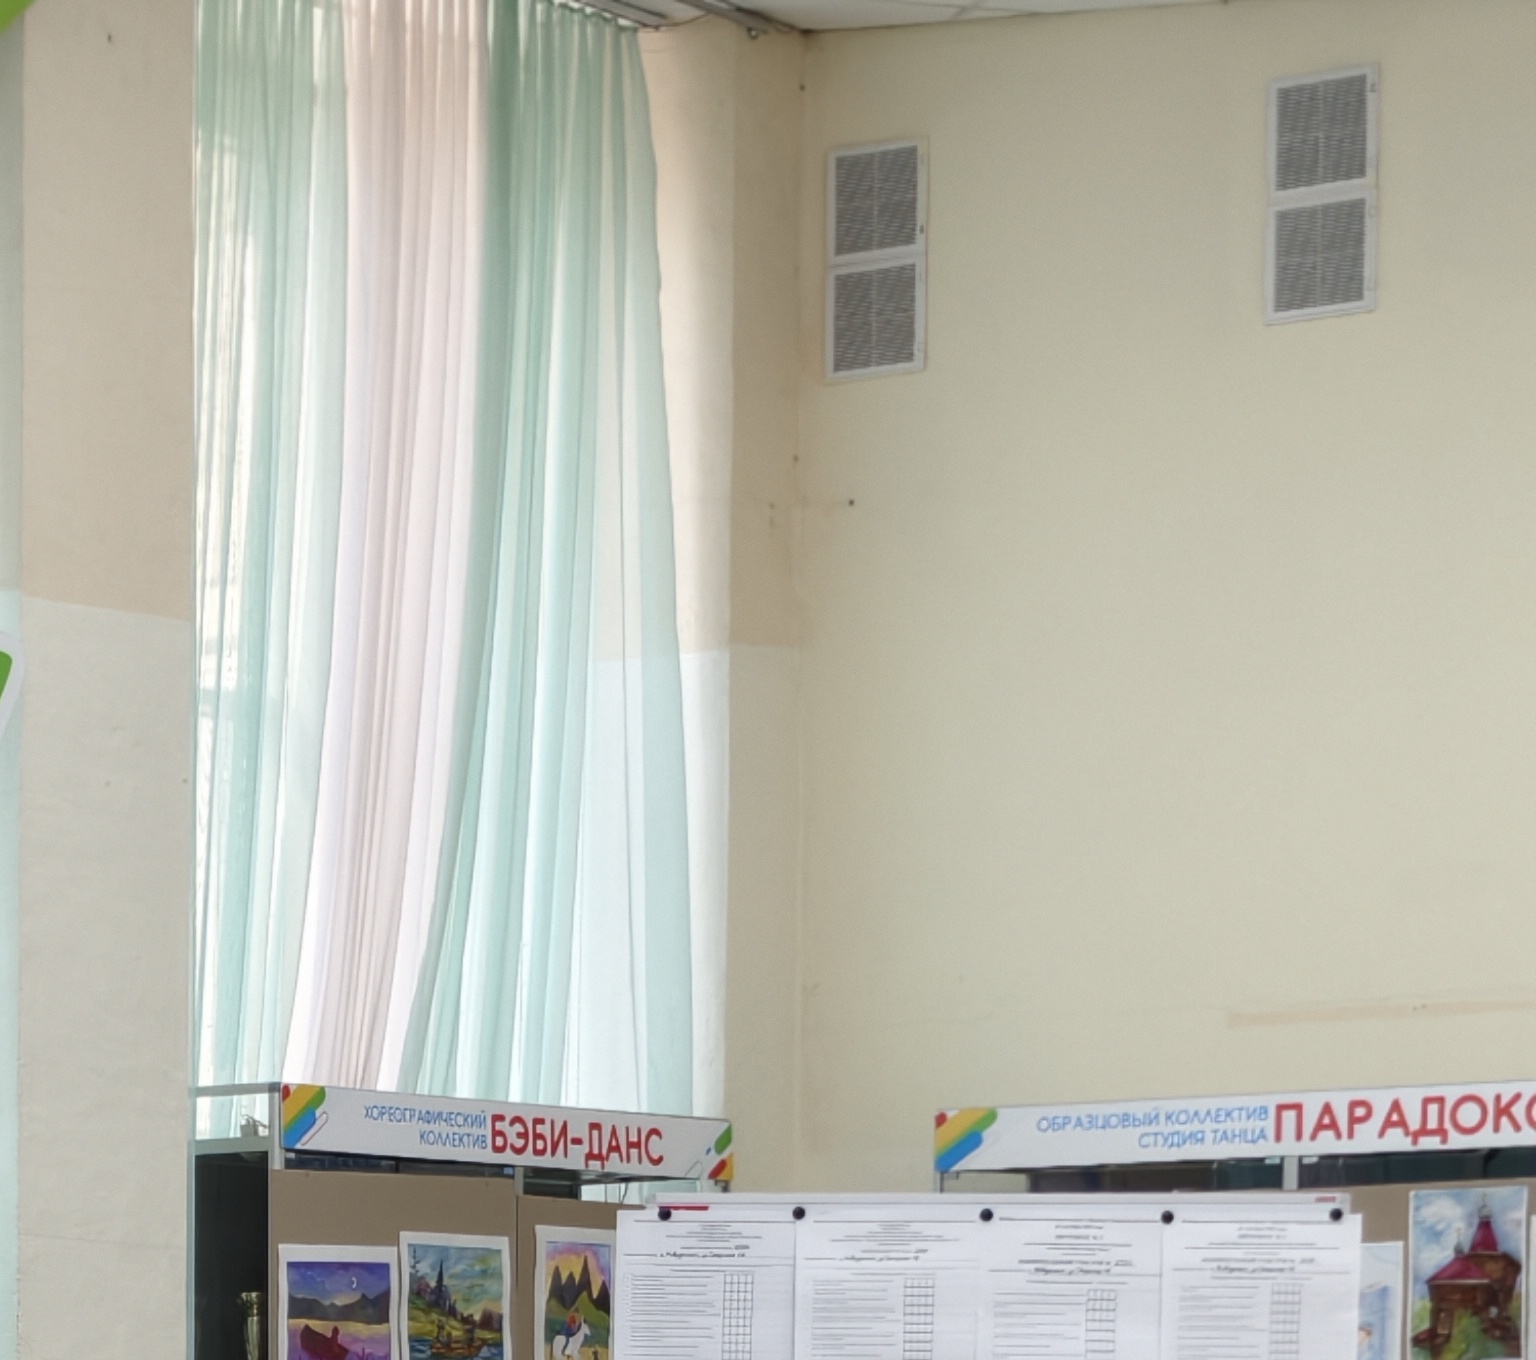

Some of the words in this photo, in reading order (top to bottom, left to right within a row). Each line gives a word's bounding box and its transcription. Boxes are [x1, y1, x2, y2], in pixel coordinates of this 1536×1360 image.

[363, 1104, 487, 1130] ХОРЕОГРАФИЧЕСКИЙ
[1036, 1107, 1160, 1133] ОБРАЗЦОВЫЙ
[1165, 1105, 1268, 1126] КОЛЛЕКТИВ
[419, 1129, 488, 1150] КОЛЛЕКТИВ
[490, 1113, 664, 1170] БЭБИ-ДАНС
[1138, 1130, 1205, 1150] СТУДИЯ
[1210, 1127, 1268, 1145] ТАНЦА
